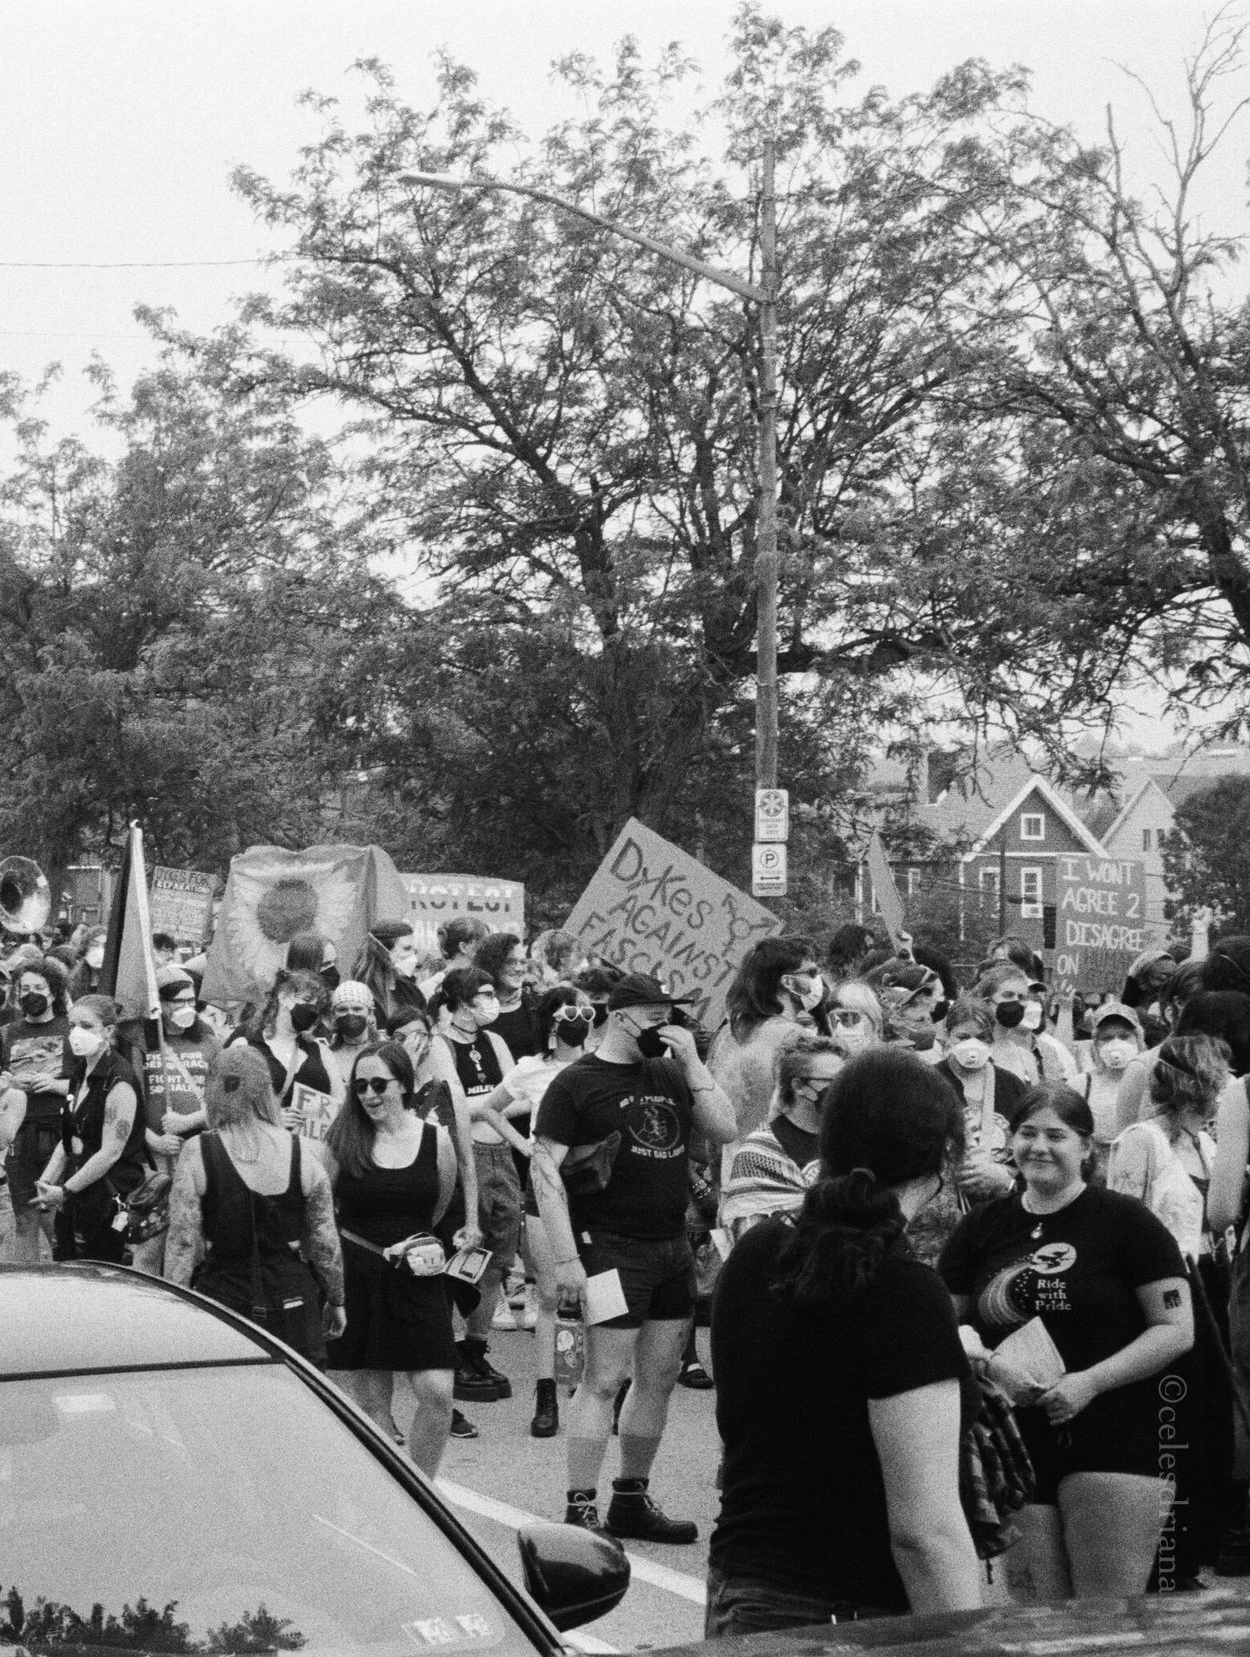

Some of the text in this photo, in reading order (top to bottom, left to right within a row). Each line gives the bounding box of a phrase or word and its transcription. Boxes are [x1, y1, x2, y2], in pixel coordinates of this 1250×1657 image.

[765, 853, 775, 865] P
[1061, 858, 1079, 880] I
[406, 880, 518, 912] ROTECT
[1061, 886, 1141, 918] AGREE 2
[606, 894, 738, 988] AGAINST
[1066, 920, 1145, 952] DISAGREE
[1057, 952, 1079, 975] ON
[1037, 1278, 1067, 1289] Ride
[1037, 1288, 1068, 1300] with
[1035, 1299, 1073, 1311] Pride
